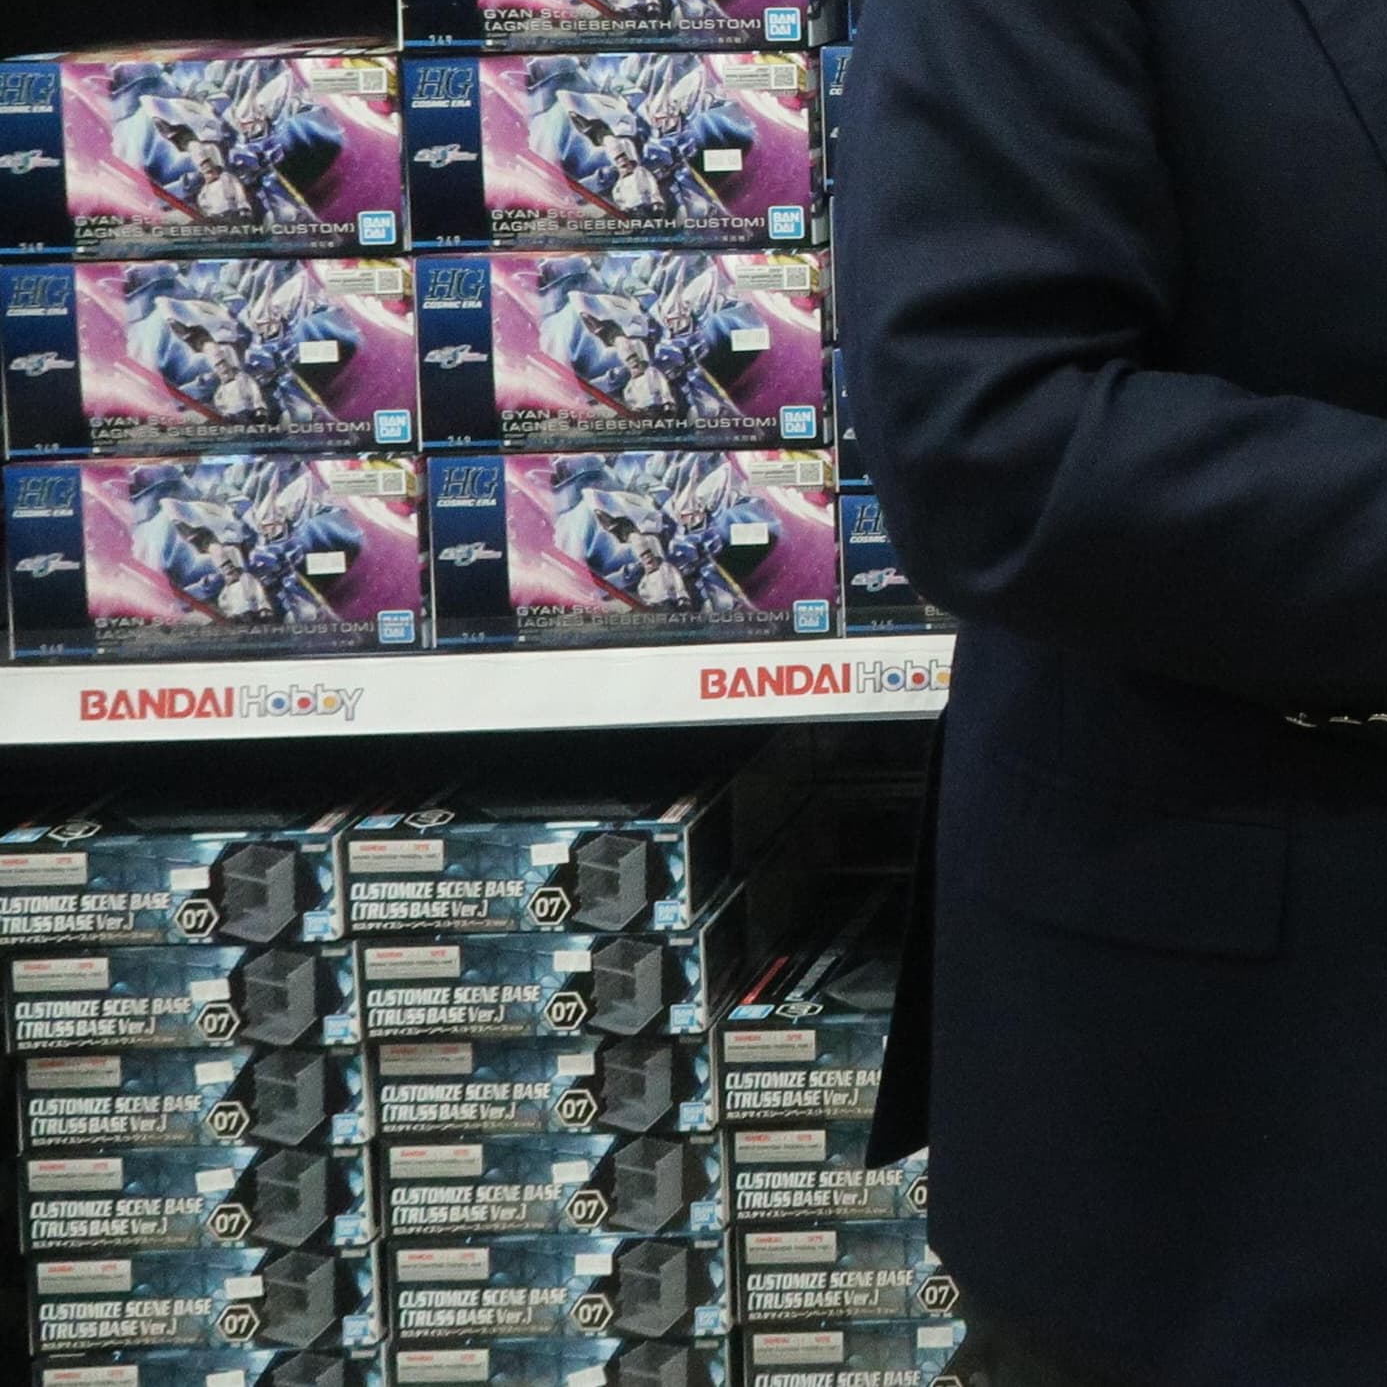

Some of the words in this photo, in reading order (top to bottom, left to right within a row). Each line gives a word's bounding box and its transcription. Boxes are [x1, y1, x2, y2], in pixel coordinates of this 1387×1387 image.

[484, 9, 533, 20] GYAN
[560, 19, 672, 32] GIEBENRATH
[567, 219, 677, 232] GIEBENRATH
[700, 663, 851, 700] BANDAI
[856, 660, 952, 694] Hobb
[80, 686, 234, 721] BANDAI
[240, 683, 364, 722] Hobby
[350, 882, 434, 901] CUSTOMIZE
[437, 881, 485, 898] SCENE
[487, 880, 524, 897] BASE
[410, 901, 449, 918] BASE
[535, 897, 561, 916] 07
[29, 1098, 111, 1116] CUSTOMIZE
[114, 1096, 161, 1114] SCENE
[163, 1095, 202, 1112] BASE
[736, 1173, 815, 1190] CUSTOMIZE
[818, 1171, 863, 1188] SCENE
[865, 1170, 903, 1186] BASE
[792, 1191, 830, 1208] BASE
